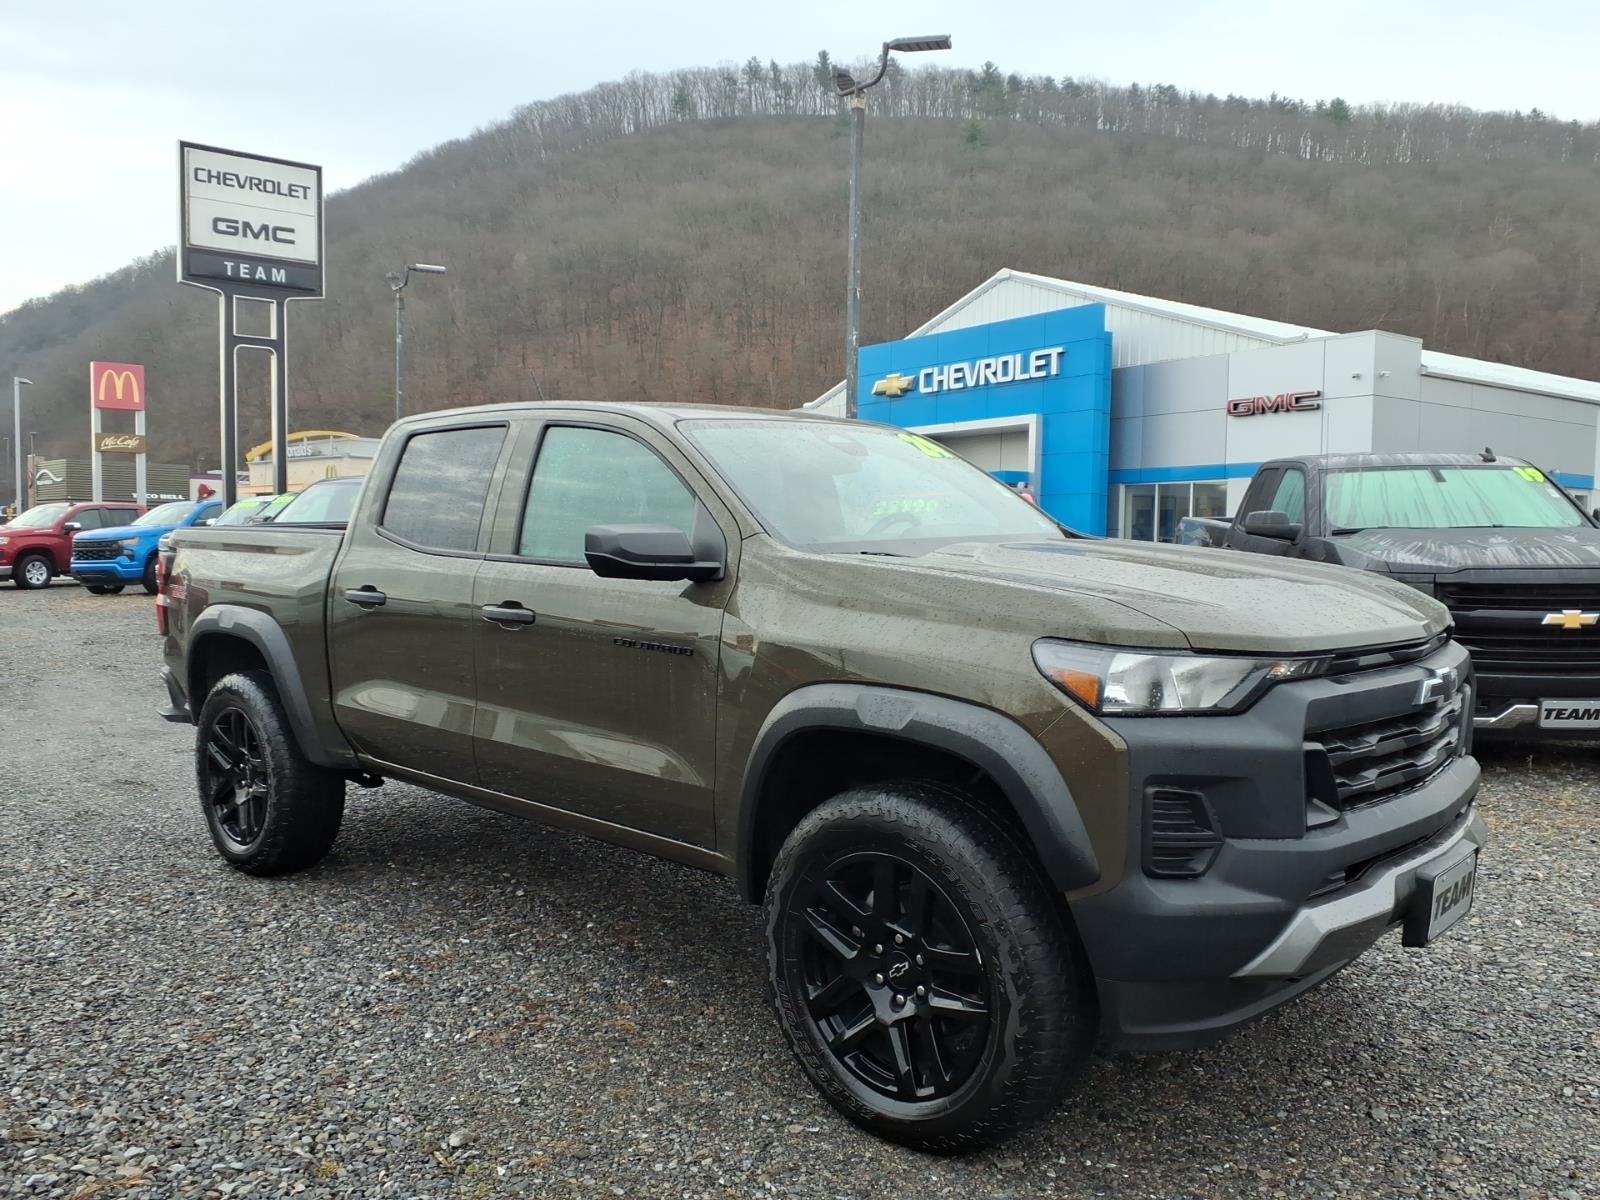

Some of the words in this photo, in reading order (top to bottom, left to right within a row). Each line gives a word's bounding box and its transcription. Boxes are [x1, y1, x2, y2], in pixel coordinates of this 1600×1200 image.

[194, 167, 311, 200] CHEVROLET
[212, 217, 295, 245] GMC
[224, 261, 286, 283] TEAM
[919, 347, 1064, 394] CHEVROLET
[1227, 391, 1321, 417] GMC
[1544, 708, 1600, 721] TEAM
[1434, 870, 1473, 921] TEAM
